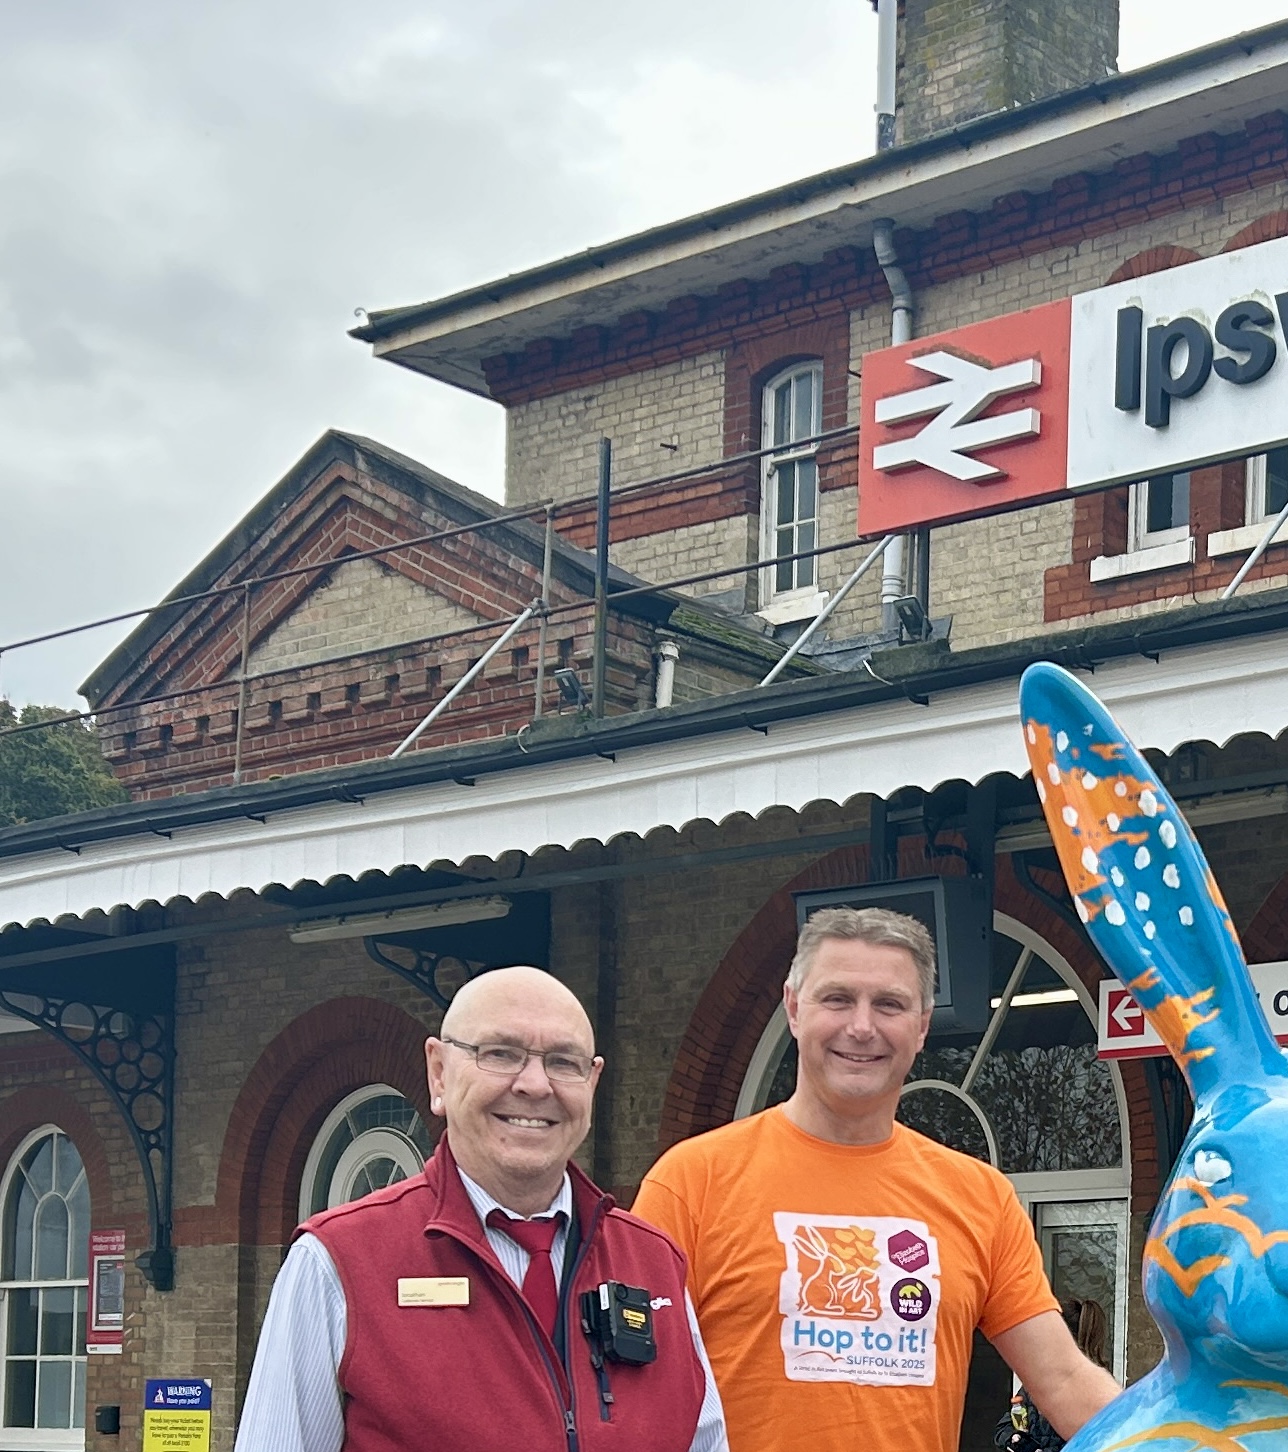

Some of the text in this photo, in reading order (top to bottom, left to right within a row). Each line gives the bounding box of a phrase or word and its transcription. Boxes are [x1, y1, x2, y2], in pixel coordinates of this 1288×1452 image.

[899, 1298, 922, 1310] WILD
[908, 1306, 923, 1315] ART
[794, 1320, 927, 1354] Hop to it!
[846, 1355, 925, 1369] SUFFOLK 2025
[167, 1386, 202, 1397] WARNING
